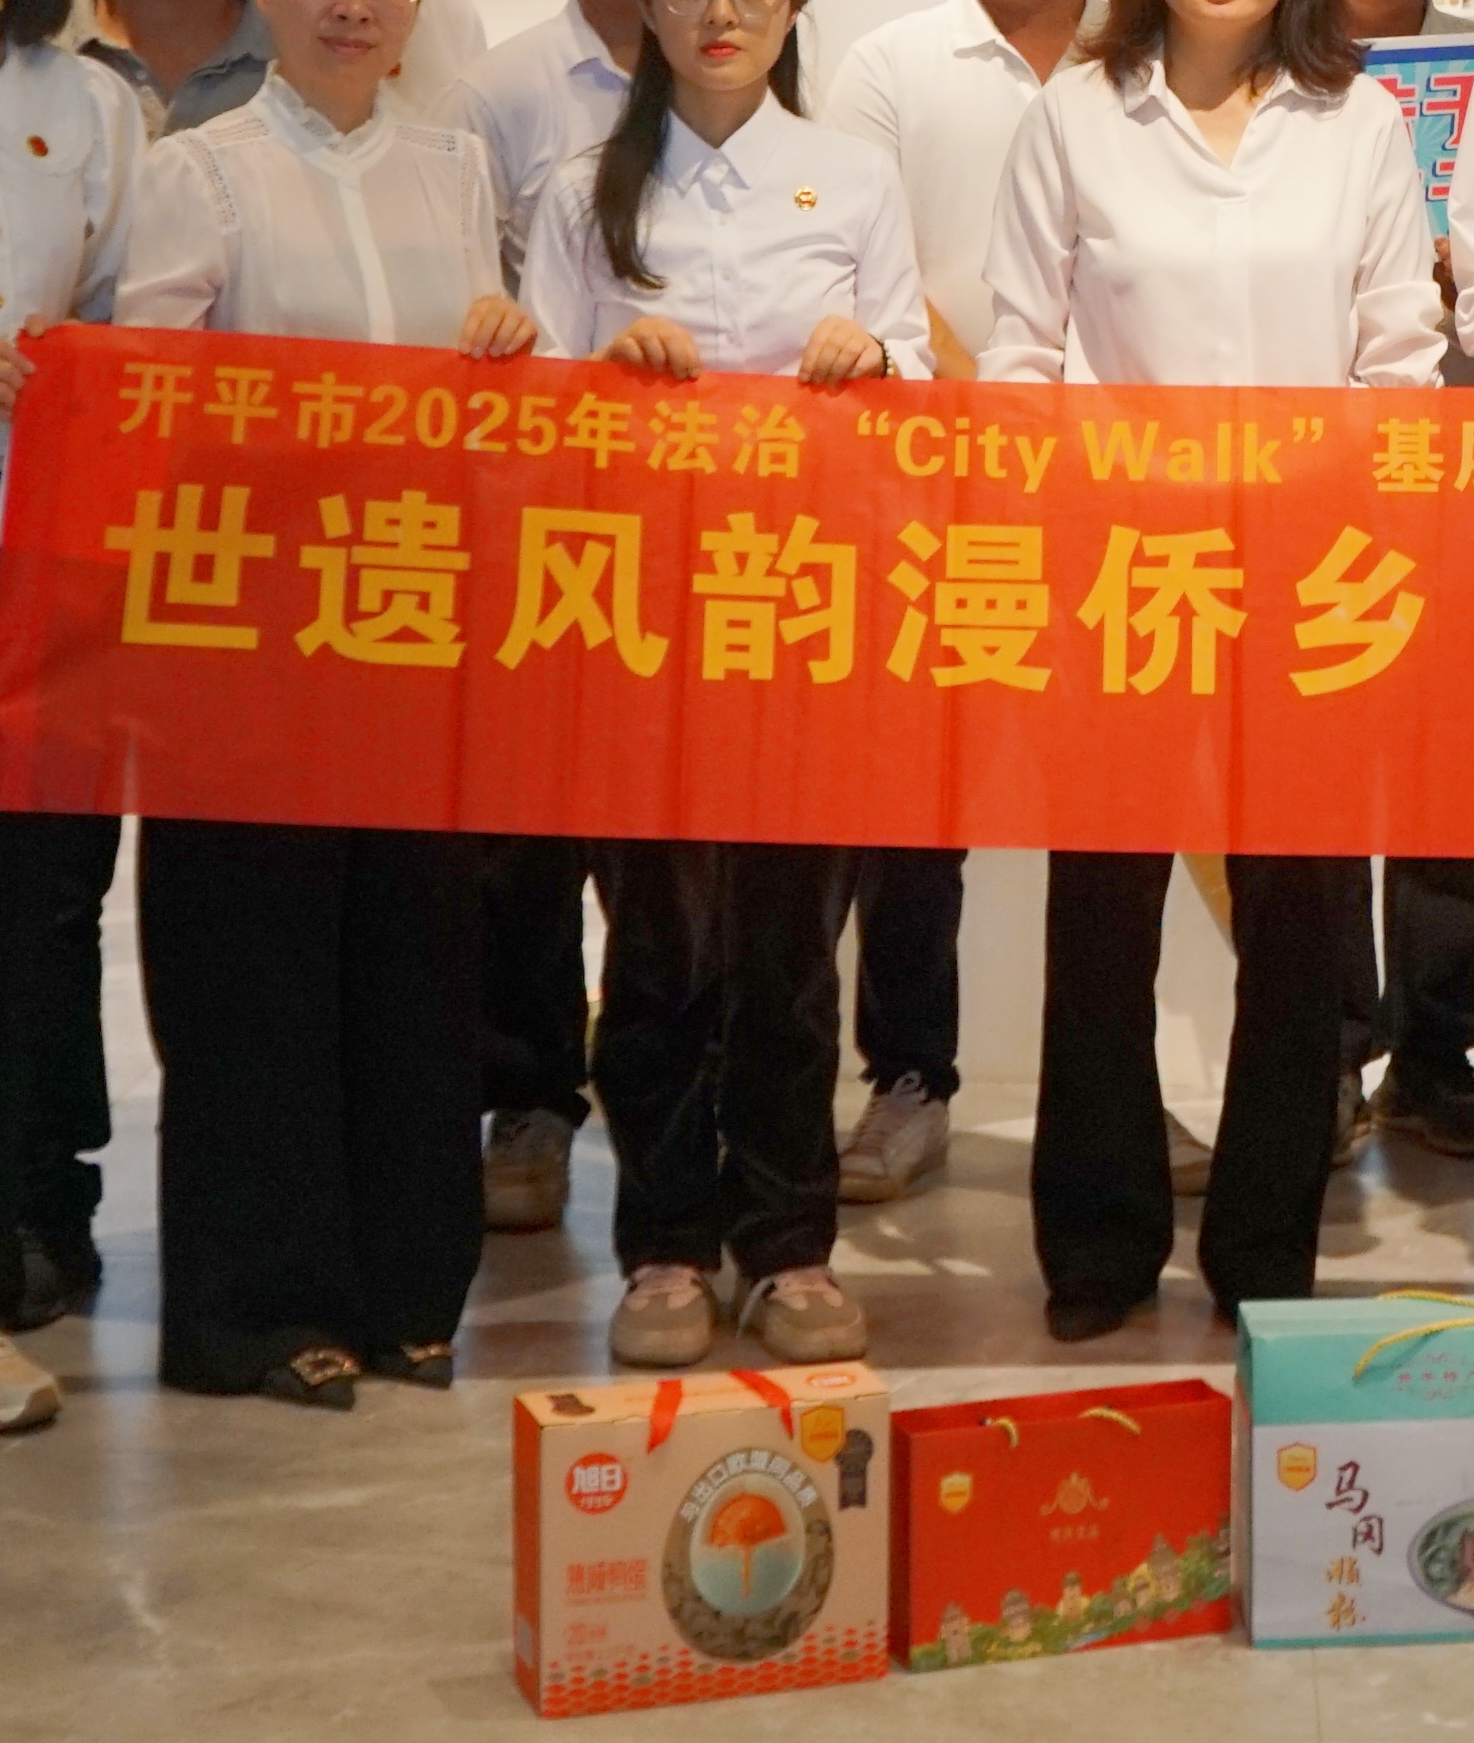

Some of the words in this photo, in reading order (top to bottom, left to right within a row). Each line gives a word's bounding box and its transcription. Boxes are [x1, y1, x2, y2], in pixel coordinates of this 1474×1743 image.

[118, 361, 807, 480] 开平市2025年法治
[104, 482, 1426, 698] 世遗风韵漫侨乡
